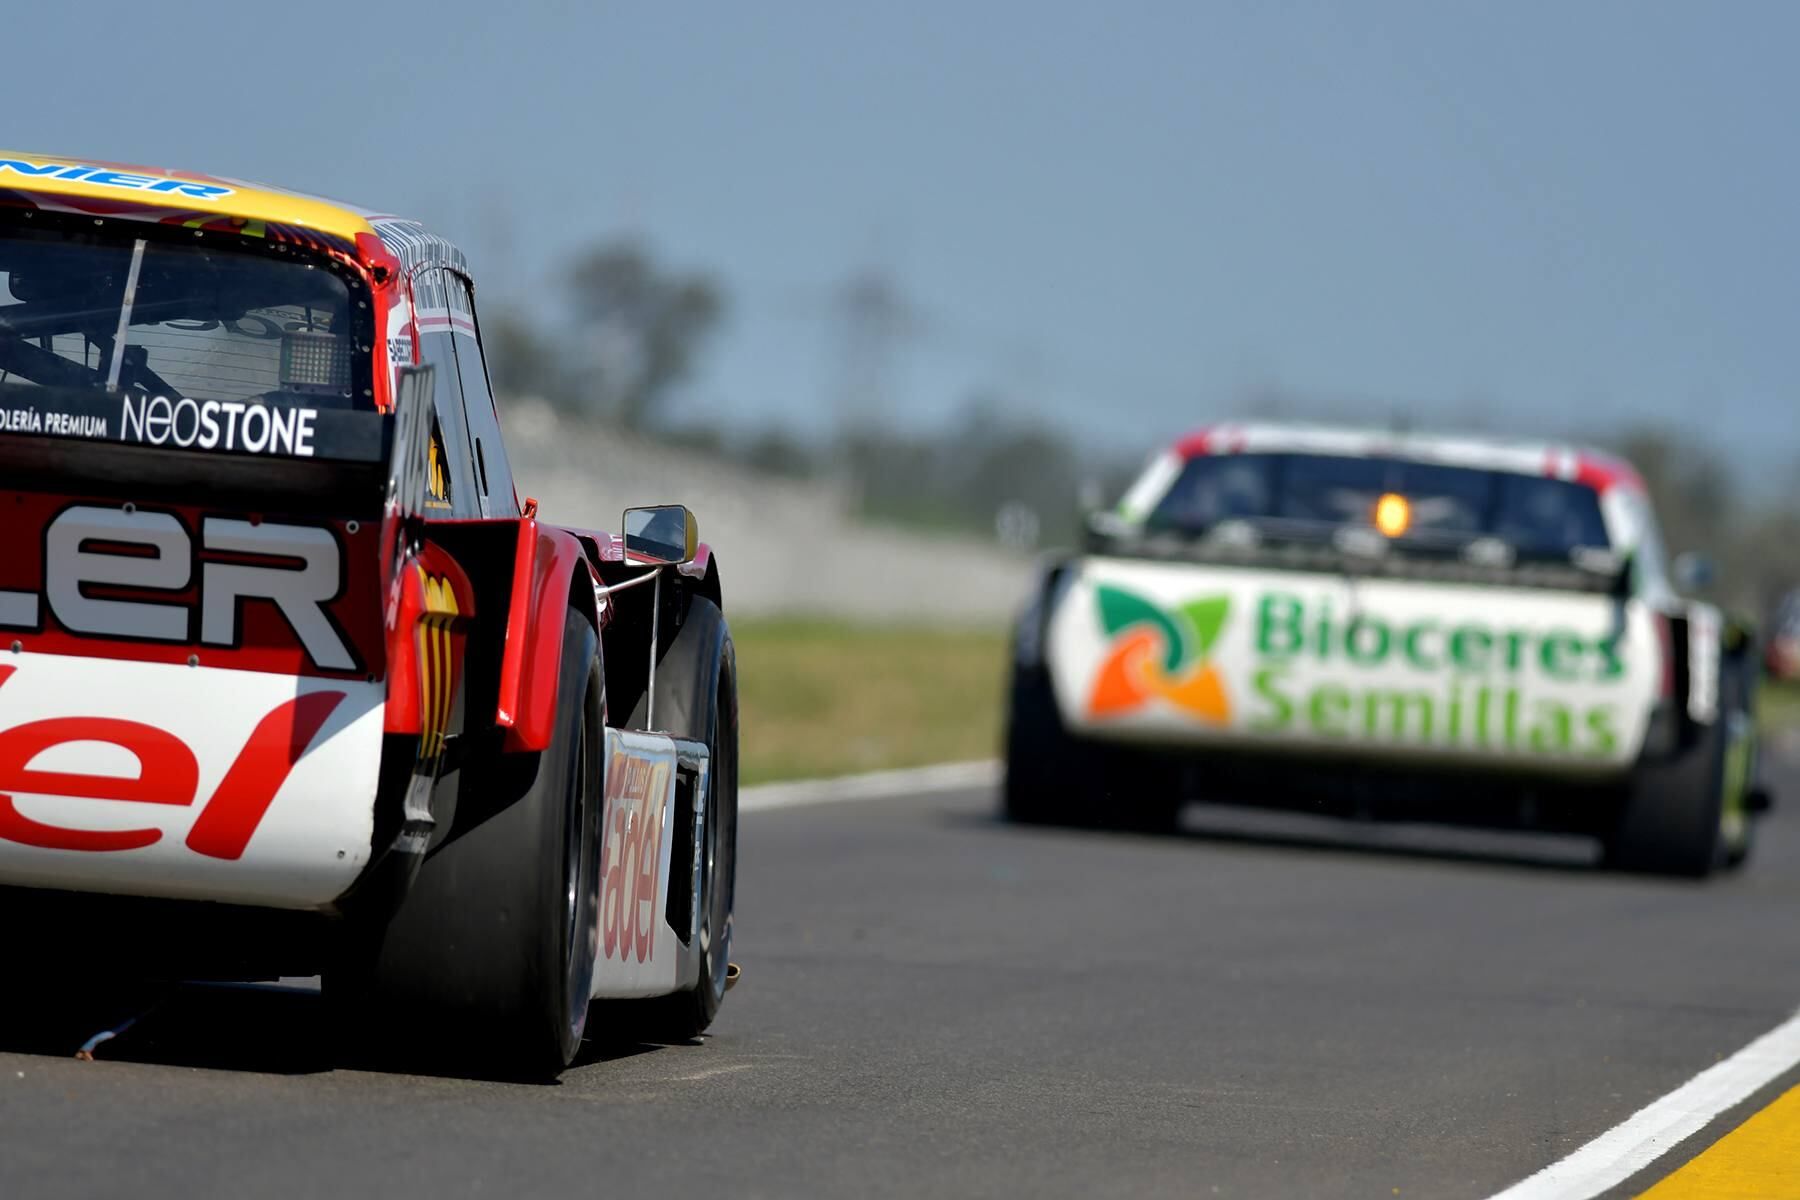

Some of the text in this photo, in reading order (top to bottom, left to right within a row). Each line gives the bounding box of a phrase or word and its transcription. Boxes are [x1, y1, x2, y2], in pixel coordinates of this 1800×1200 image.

[45, 412, 107, 437] PREMIUM
[1252, 592, 1627, 682] Bioceres
[1249, 664, 1619, 757] Semillas
